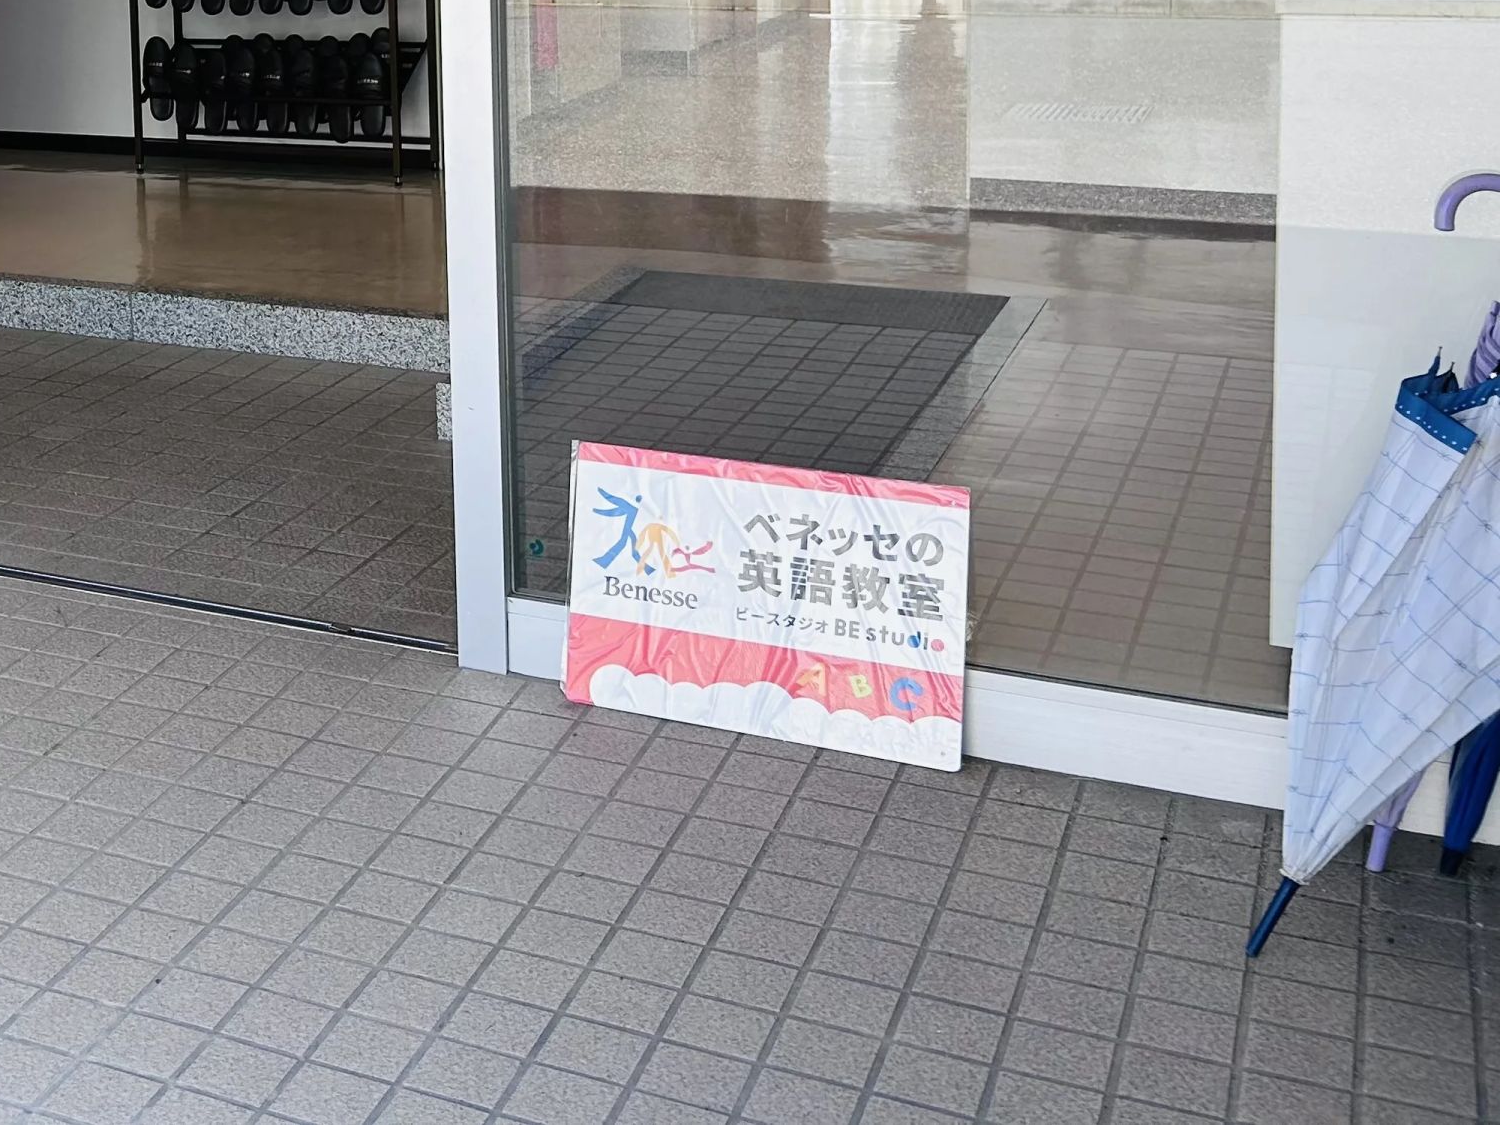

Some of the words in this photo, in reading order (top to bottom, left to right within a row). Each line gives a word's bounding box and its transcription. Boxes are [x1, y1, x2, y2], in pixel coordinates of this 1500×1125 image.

[743, 513, 945, 567] ベネッセの
[602, 575, 699, 610] Benesse
[737, 548, 946, 621] 英語教室
[736, 607, 829, 634] ビースタジオ
[834, 618, 861, 639] BE
[866, 625, 945, 652] studio
